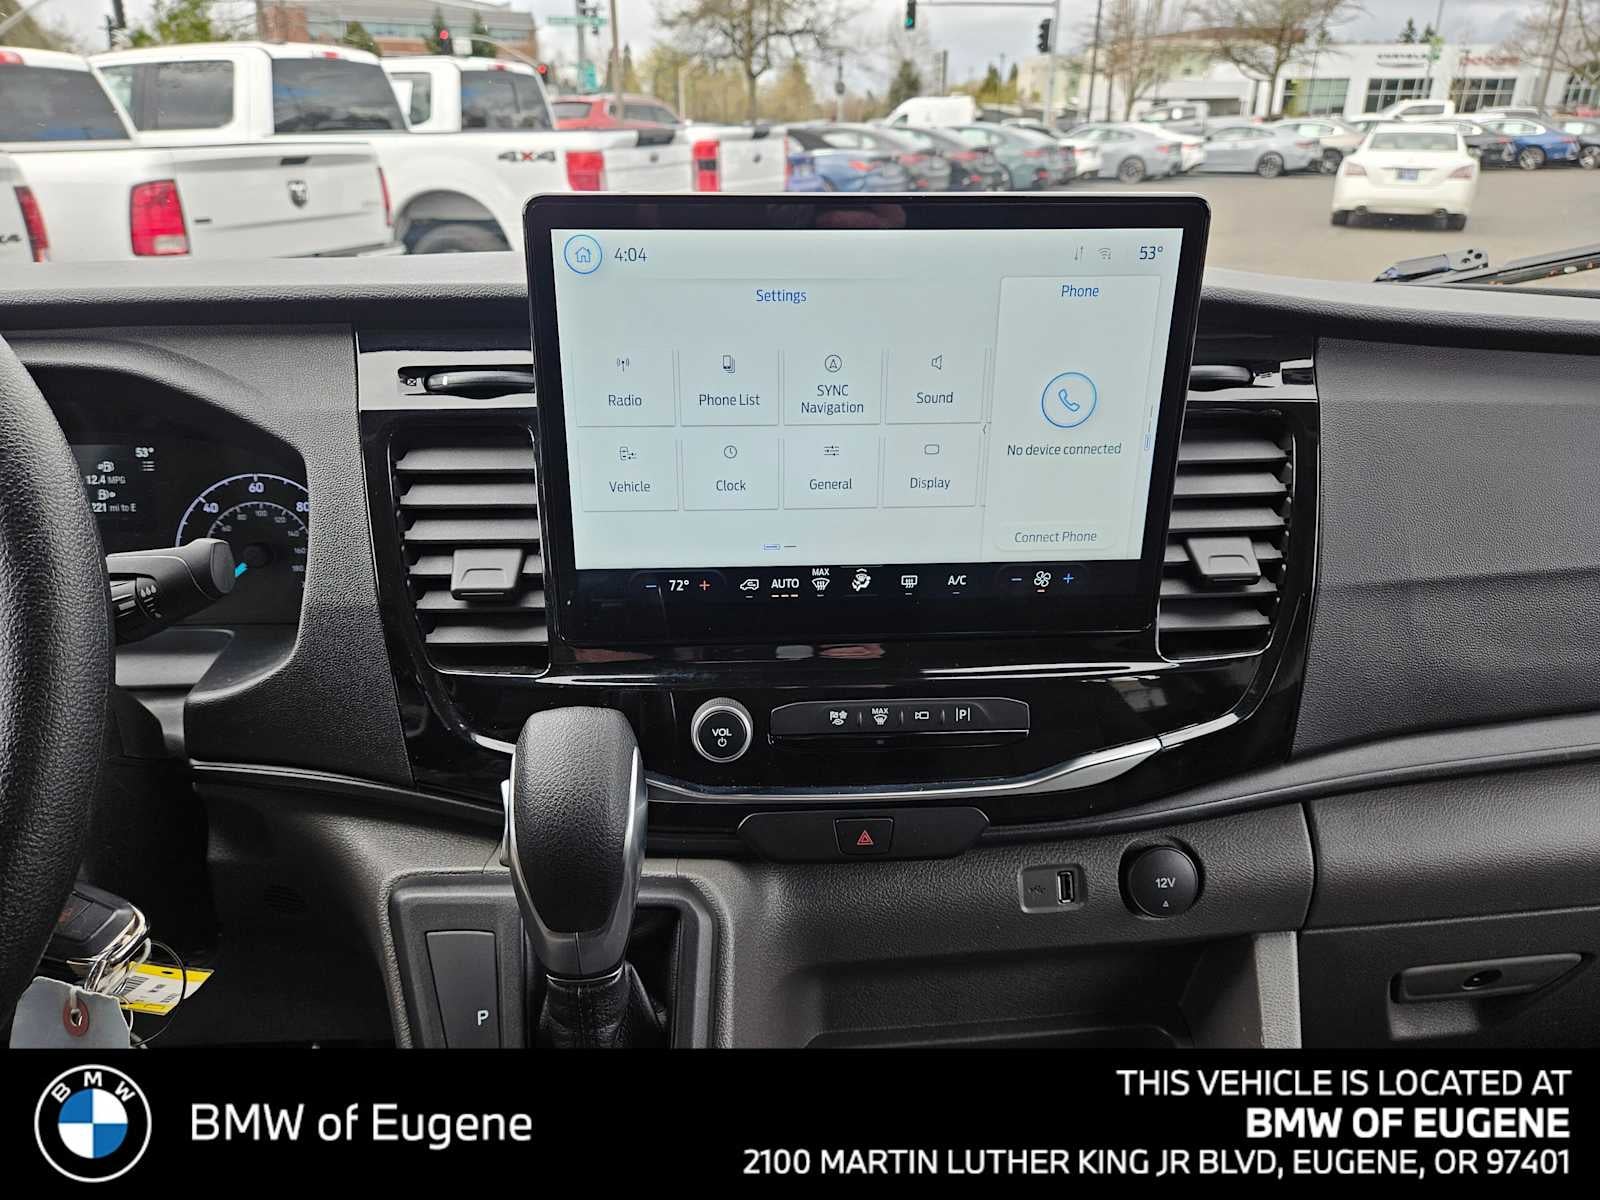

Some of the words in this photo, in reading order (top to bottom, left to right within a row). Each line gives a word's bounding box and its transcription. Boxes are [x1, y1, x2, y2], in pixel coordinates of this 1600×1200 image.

[614, 247, 648, 262] 4:04
[1138, 245, 1164, 260] 53°
[756, 288, 807, 304] Settings
[1061, 284, 1100, 297] Phone
[817, 384, 849, 397] SYNC
[608, 393, 643, 407] Radio
[699, 393, 737, 406] Phone
[739, 393, 761, 406] List
[916, 391, 954, 405] Sound
[801, 401, 864, 416] Navigation
[1007, 443, 1023, 456] No
[1025, 442, 1061, 456] device
[1063, 442, 1122, 456] connected
[86, 474, 106, 485] 12.4
[715, 479, 747, 492] Clock
[809, 477, 853, 491] General
[910, 476, 951, 490] Display
[248, 481, 265, 493] 60
[609, 480, 650, 493] Vehicle
[203, 502, 219, 514] 40
[295, 501, 311, 513] 80
[1014, 530, 1060, 544] Connect
[1062, 530, 1097, 543] Phone
[811, 567, 830, 577] MAX
[668, 578, 690, 592] 72°
[770, 578, 800, 589] AUTO
[947, 574, 967, 586] A/C
[871, 707, 889, 716] MAX
[711, 727, 733, 738] VOL
[1155, 877, 1176, 889] 12V
[477, 1009, 489, 1026] P
